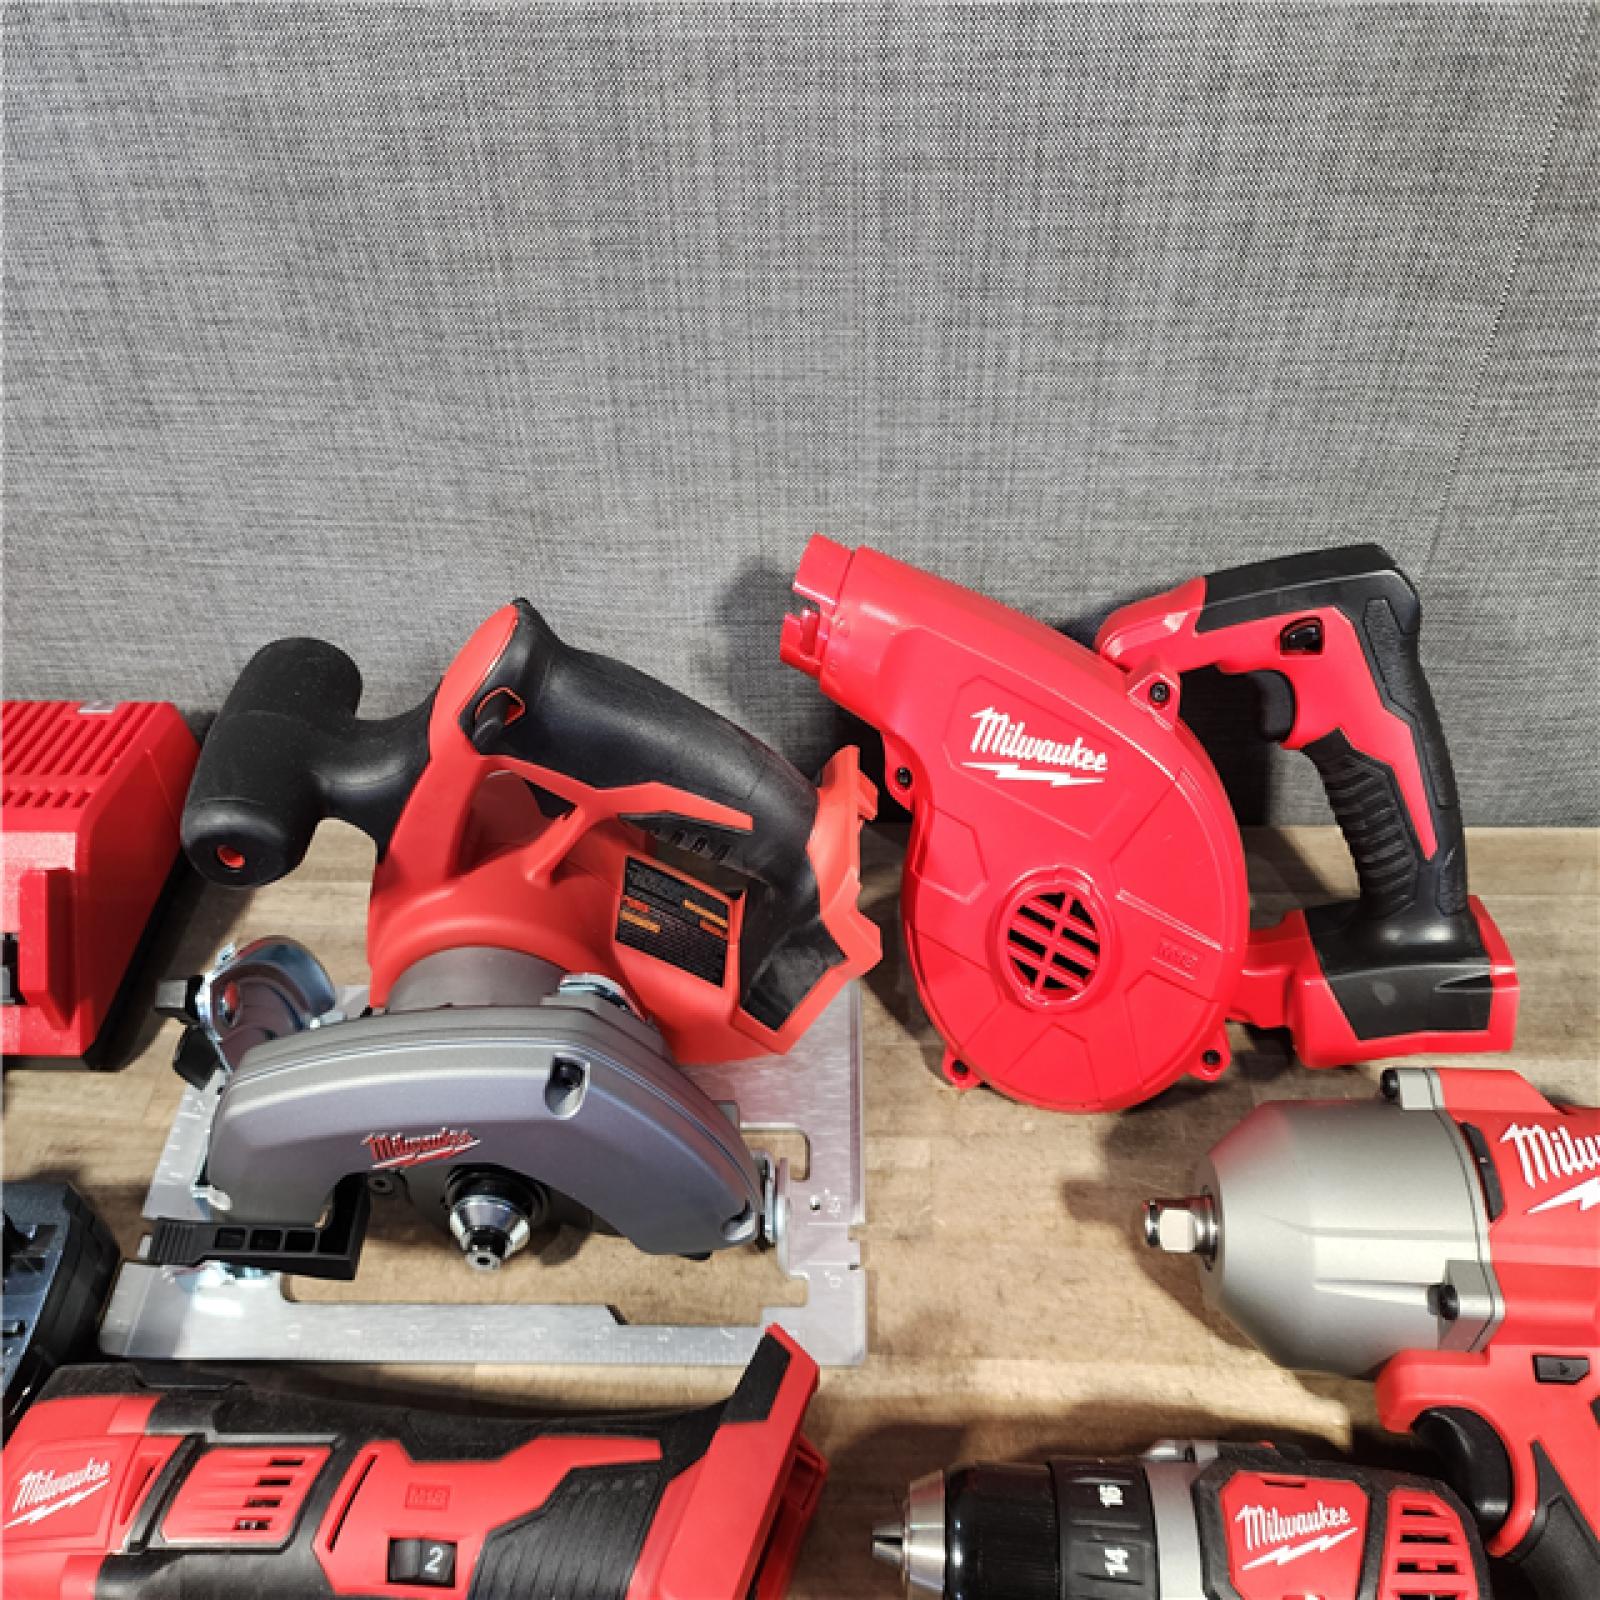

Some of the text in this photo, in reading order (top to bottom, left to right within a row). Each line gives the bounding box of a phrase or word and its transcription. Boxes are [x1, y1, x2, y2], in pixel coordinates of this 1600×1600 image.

[970, 705, 1108, 771] Milwaukee
[360, 1126, 473, 1160] Milwaukee
[12, 1456, 110, 1513] Milwaukee
[1235, 1500, 1351, 1551] Milwaukee
[424, 1546, 444, 1573] 2
[1105, 1547, 1129, 1576] 14
